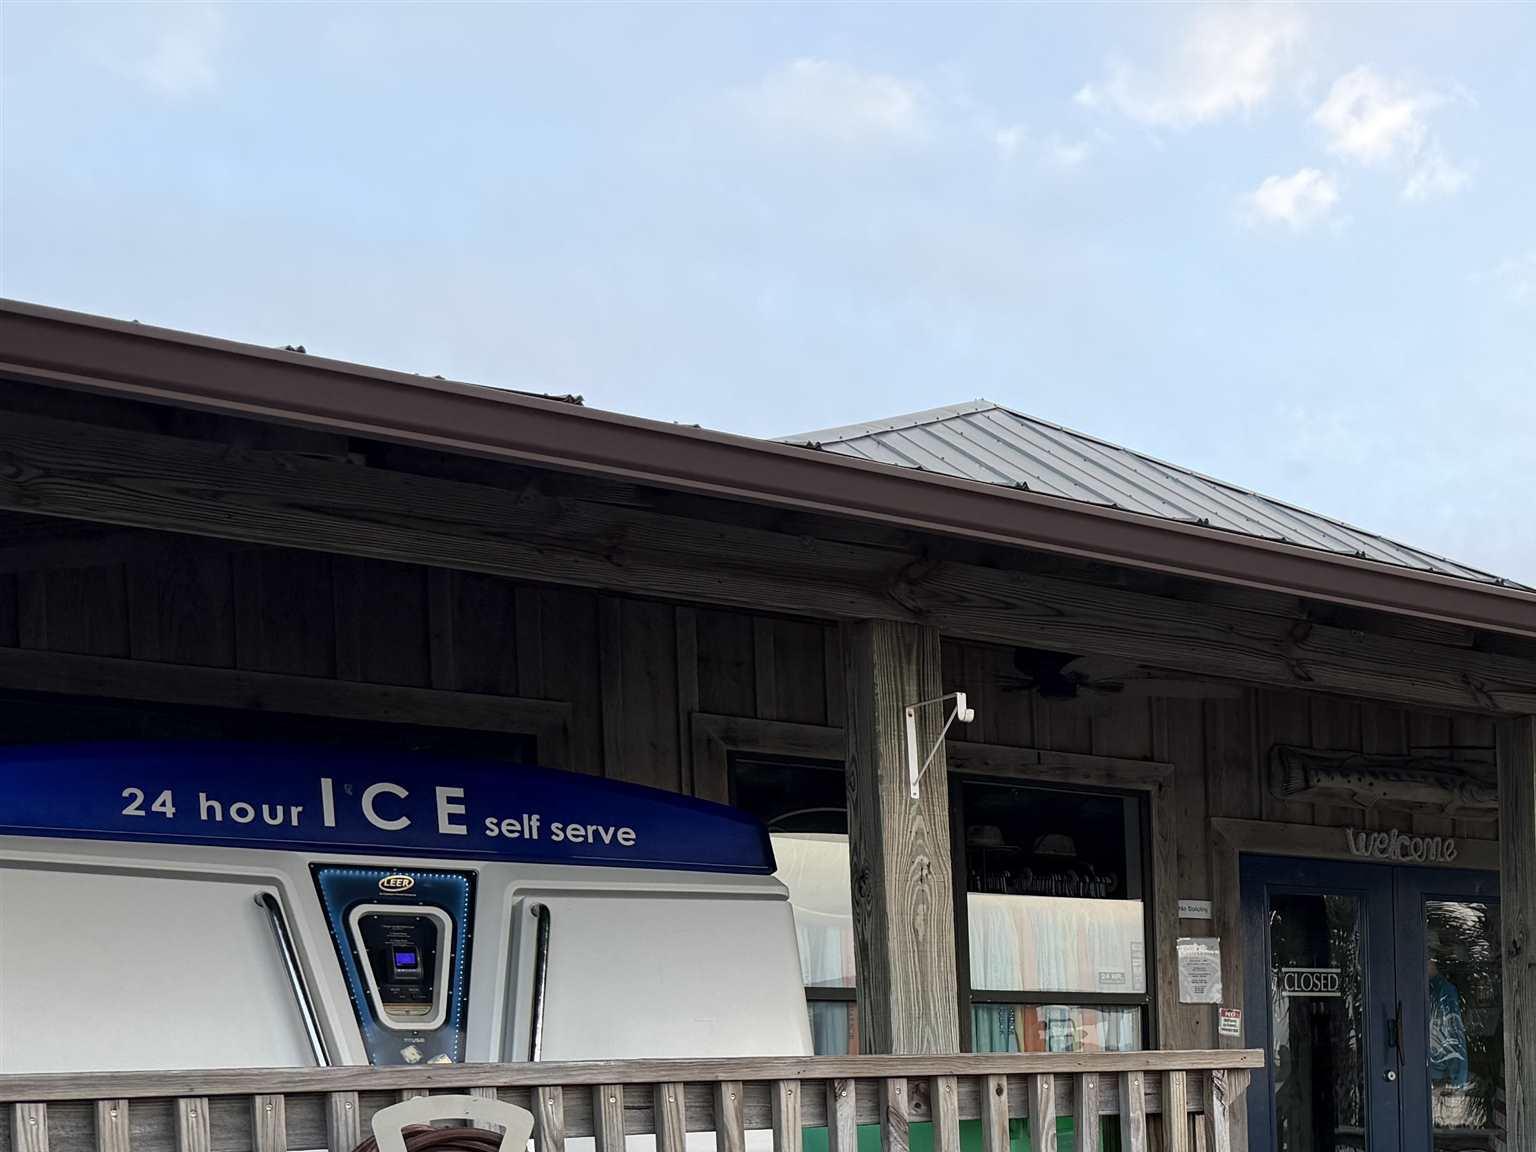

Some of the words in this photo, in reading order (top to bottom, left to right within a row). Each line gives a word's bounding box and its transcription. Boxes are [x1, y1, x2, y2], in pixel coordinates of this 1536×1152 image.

[121, 787, 176, 818] 24
[199, 792, 303, 827] hour
[321, 777, 468, 836] ICE
[484, 813, 541, 841] self
[550, 820, 637, 846] serve
[383, 879, 410, 887] LEER
[1284, 972, 1339, 991] CLOSED
